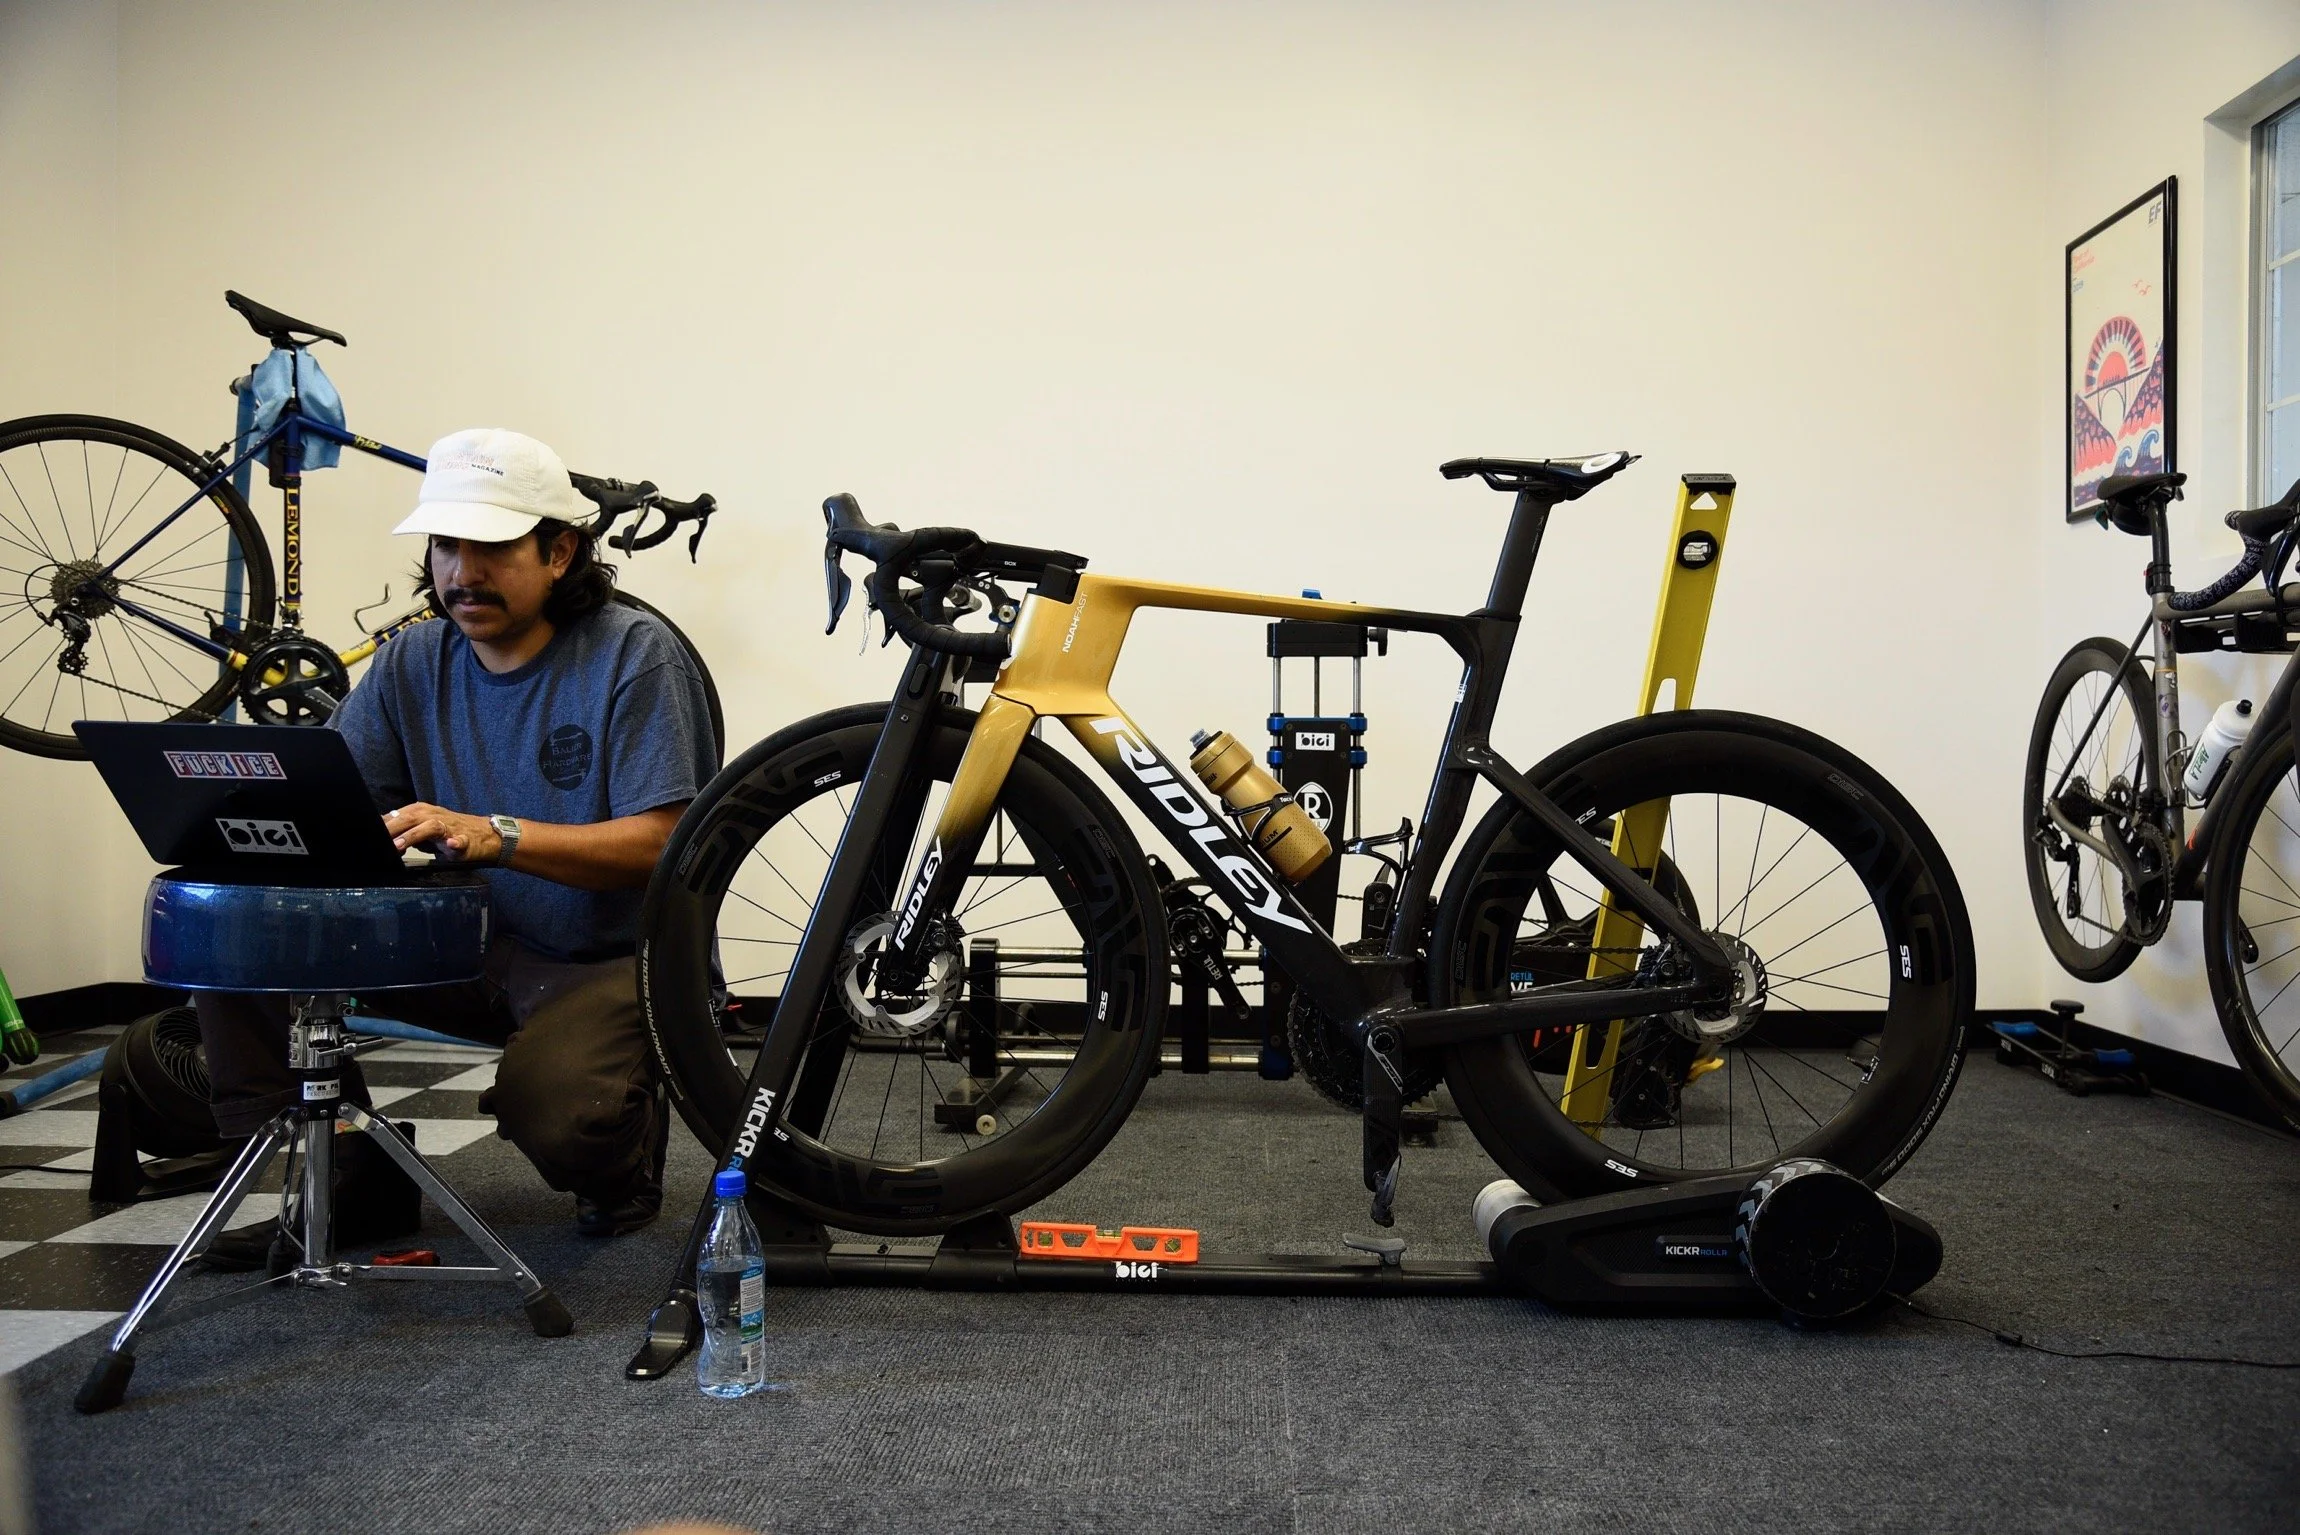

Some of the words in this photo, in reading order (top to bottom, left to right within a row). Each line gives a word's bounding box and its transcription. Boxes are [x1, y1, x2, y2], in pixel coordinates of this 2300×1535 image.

[2148, 200, 2162, 224] EF
[471, 463, 504, 477] MAGAZINE
[287, 487, 300, 595] LEMOND
[1301, 734, 1330, 747] bici
[169, 754, 235, 775] FUCK
[232, 755, 280, 776] ICE
[814, 771, 842, 788] SES
[1089, 716, 1313, 934] RIDLEY
[1575, 806, 1597, 825] ES
[219, 820, 303, 848] bici
[895, 835, 942, 951] RIDLEY
[1900, 945, 1911, 979] SES
[642, 958, 650, 998] 5000
[644, 998, 656, 1031] PRIX
[1097, 991, 1108, 1021] SES
[734, 1087, 776, 1158] KICKR
[773, 1127, 790, 1142] SE
[1604, 1159, 1639, 1178] SES
[1665, 1246, 1700, 1256] KICKR
